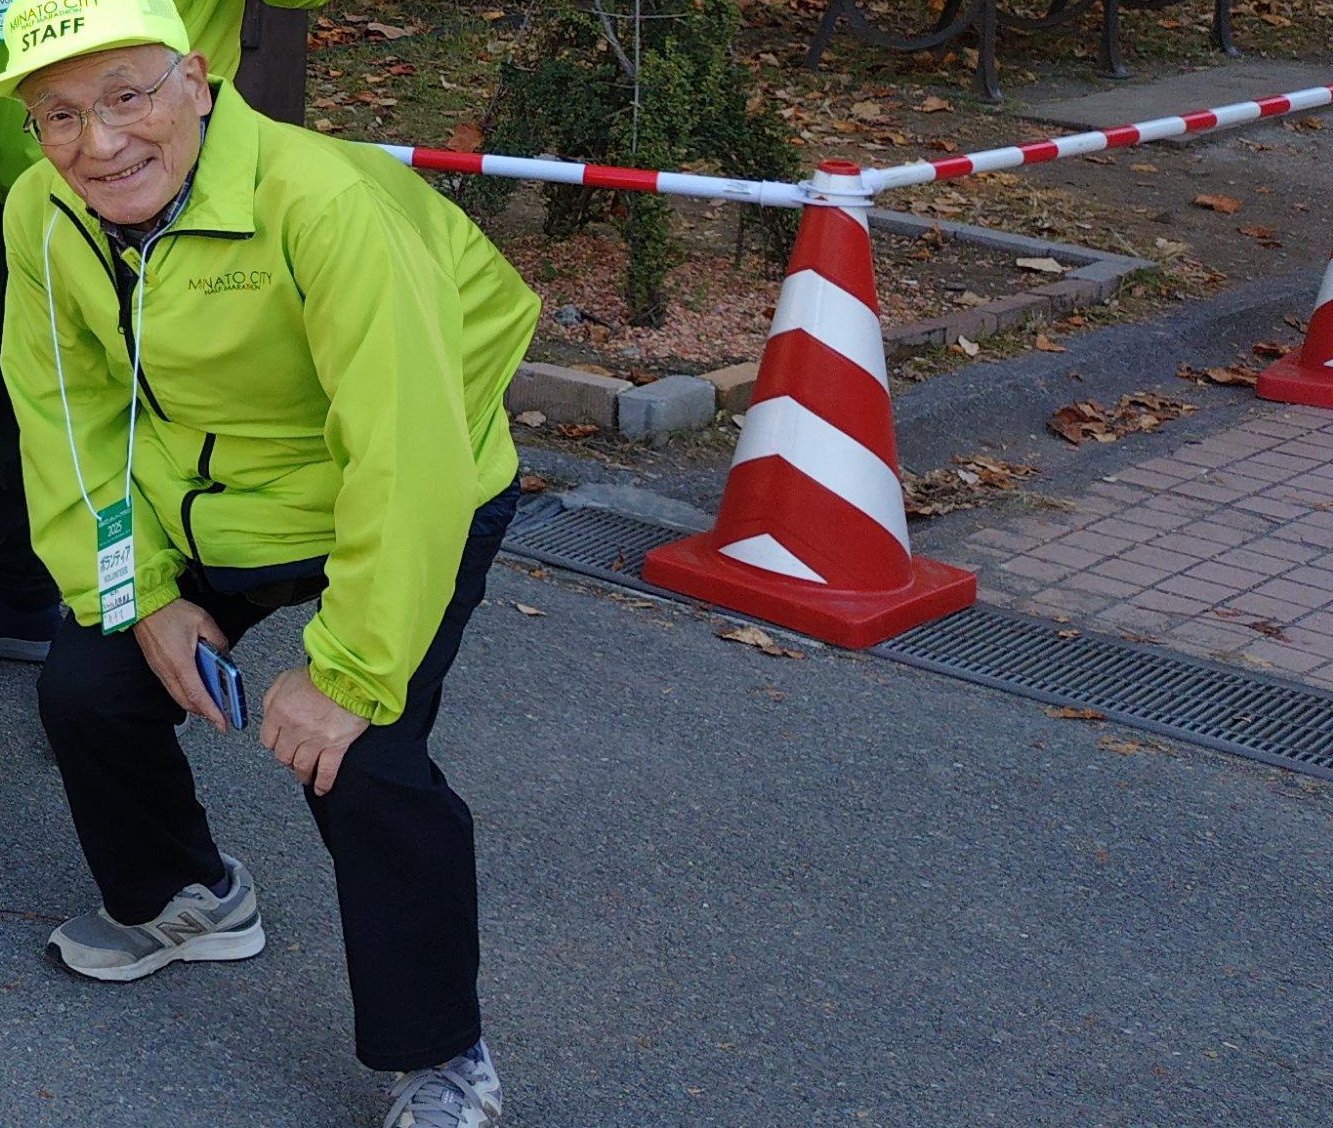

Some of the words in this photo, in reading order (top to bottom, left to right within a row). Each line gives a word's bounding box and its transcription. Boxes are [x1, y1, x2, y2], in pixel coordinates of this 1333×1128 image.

[10, 0, 58, 33] MINATO
[22, 17, 85, 52] STAFF
[188, 271, 245, 290] MINATO
[250, 270, 273, 285] CITY
[107, 520, 123, 537] 2025
